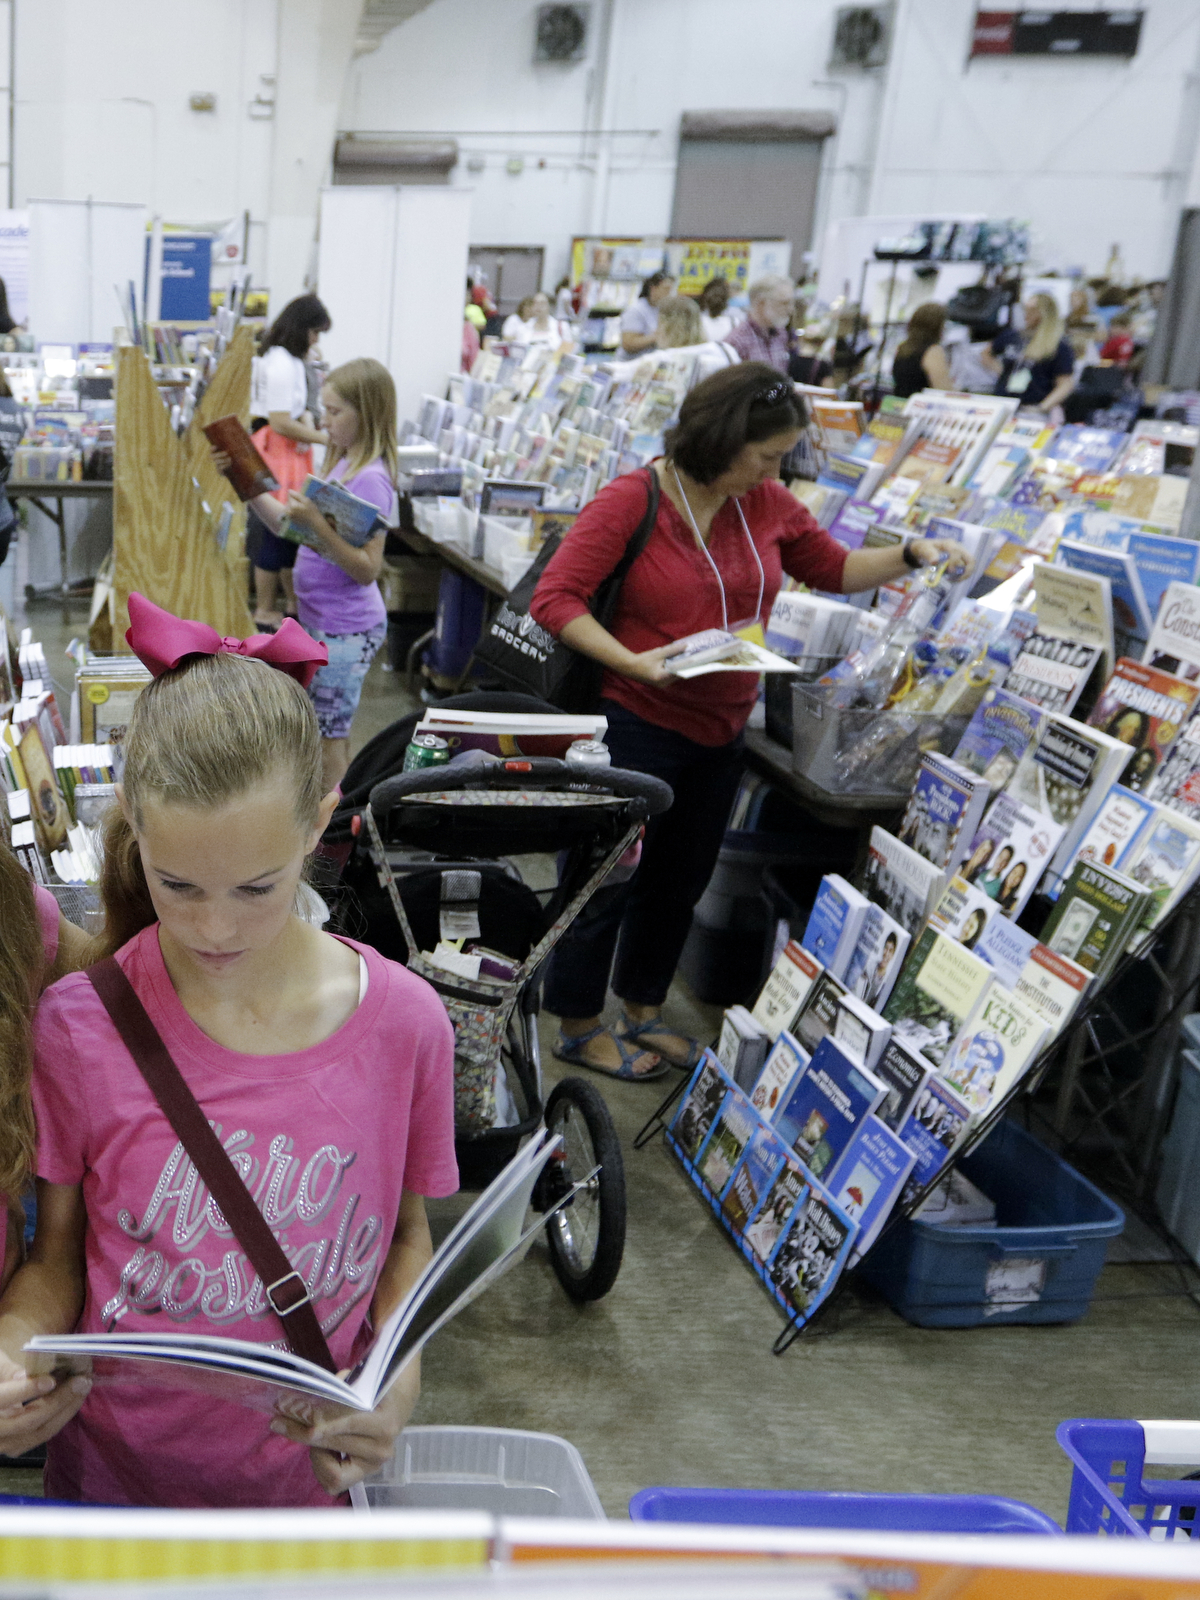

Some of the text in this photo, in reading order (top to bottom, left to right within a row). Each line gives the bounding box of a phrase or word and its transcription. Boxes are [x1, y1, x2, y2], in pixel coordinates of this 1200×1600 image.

[490, 624, 548, 663] GROCERY
[1019, 656, 1075, 687] PRESIDENTS
[1104, 674, 1187, 726] PRESIDENTS
[1078, 865, 1134, 906] INVEST
[933, 942, 983, 980] TENNESSEE
[994, 929, 1026, 954] PLEDGE
[1011, 976, 1066, 1017] CONSTITUTION
[1037, 976, 1051, 989] THE
[976, 998, 1033, 1048] KIDS
[884, 1045, 924, 1082] Economics
[858, 1132, 902, 1174] BASICS PLEASE!
[871, 1131, 898, 1159] JUST THE
[803, 1196, 848, 1248] Walt Disney
